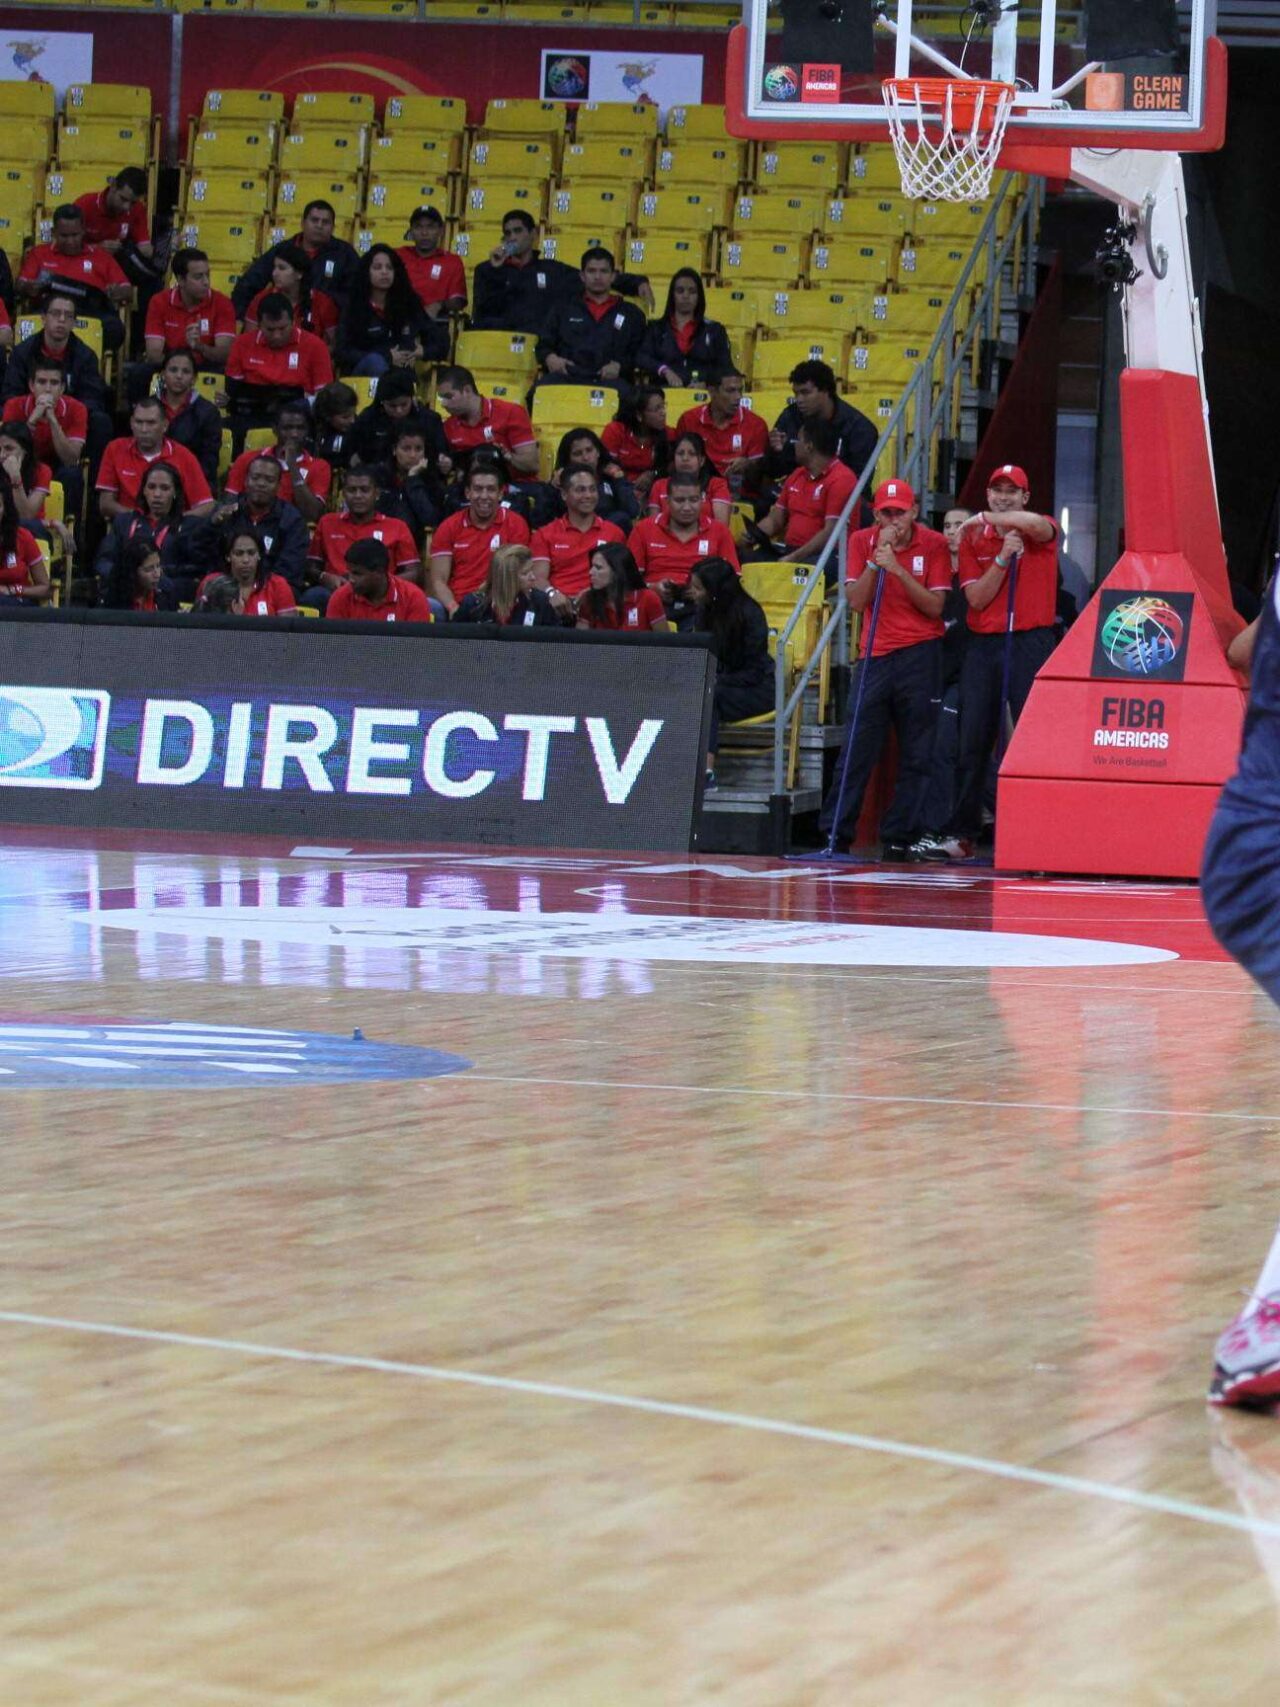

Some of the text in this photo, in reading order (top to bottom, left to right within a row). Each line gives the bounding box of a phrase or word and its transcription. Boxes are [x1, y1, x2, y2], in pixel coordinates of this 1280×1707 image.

[808, 69, 835, 80] FIBA
[1133, 76, 1182, 91] CLEAN
[1133, 93, 1181, 109] GAME
[1101, 697, 1165, 729] FIBA
[1093, 729, 1169, 749] AMERICAS
[137, 698, 664, 804] DIRECTV
